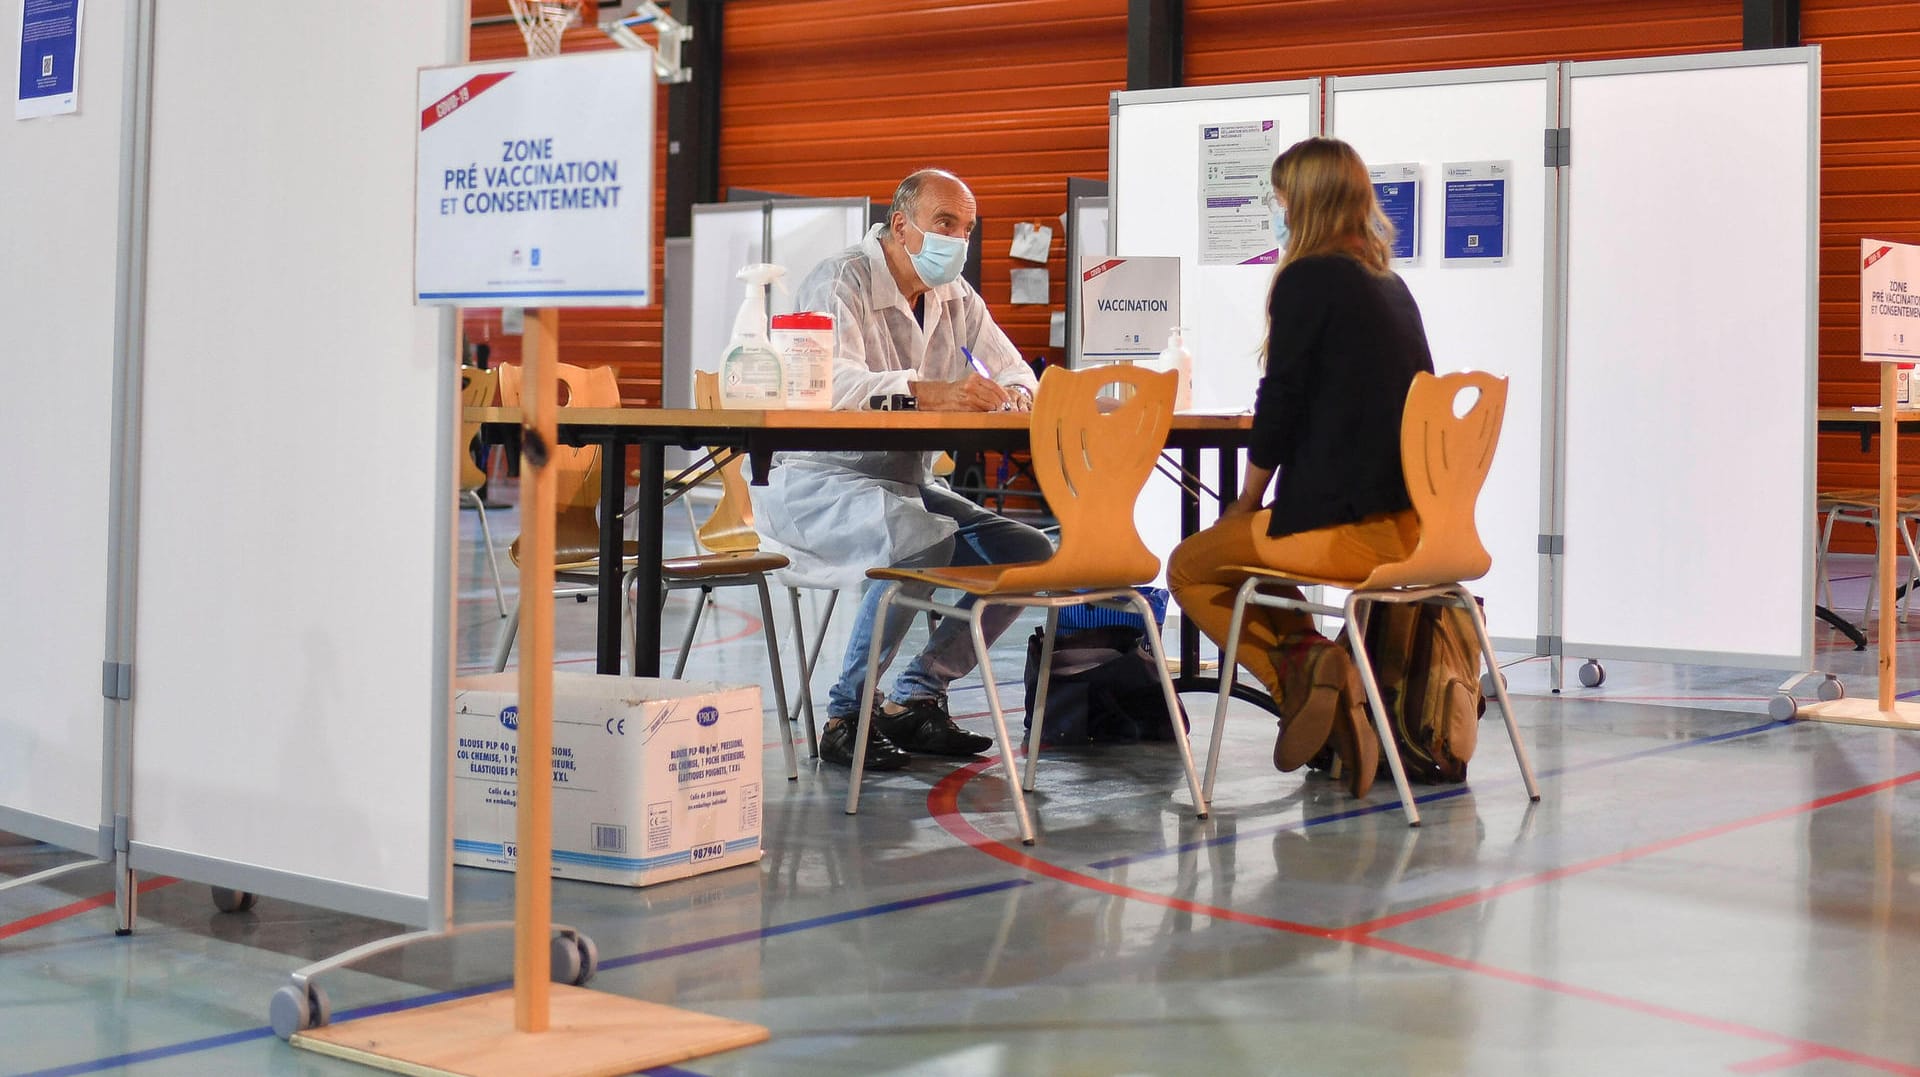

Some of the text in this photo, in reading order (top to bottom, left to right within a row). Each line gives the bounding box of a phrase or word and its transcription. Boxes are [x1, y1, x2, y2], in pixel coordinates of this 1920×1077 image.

[502, 138, 552, 162] ZONE
[444, 160, 617, 190] PRÉ VACCINATION
[440, 186, 620, 215] ET CONSENTEMENT
[1889, 280, 1907, 292] ZONE
[1872, 289, 1920, 305] PRÉ VACCINATIO
[1097, 299, 1168, 312] VACCINATION
[1871, 304, 1878, 314] ET
[698, 711, 718, 723] PROP
[459, 738, 483, 749] BLOUSE
[486, 741, 498, 750] PLP
[500, 742, 509, 751] 40
[688, 746, 698, 756] PLP
[457, 750, 469, 760] COL
[470, 751, 502, 763] CHEMISE,
[504, 755, 507, 763] 1
[470, 761, 508, 776] ÉLASTIQUES
[493, 798, 517, 808] emballag
[693, 847, 722, 861] 987940
